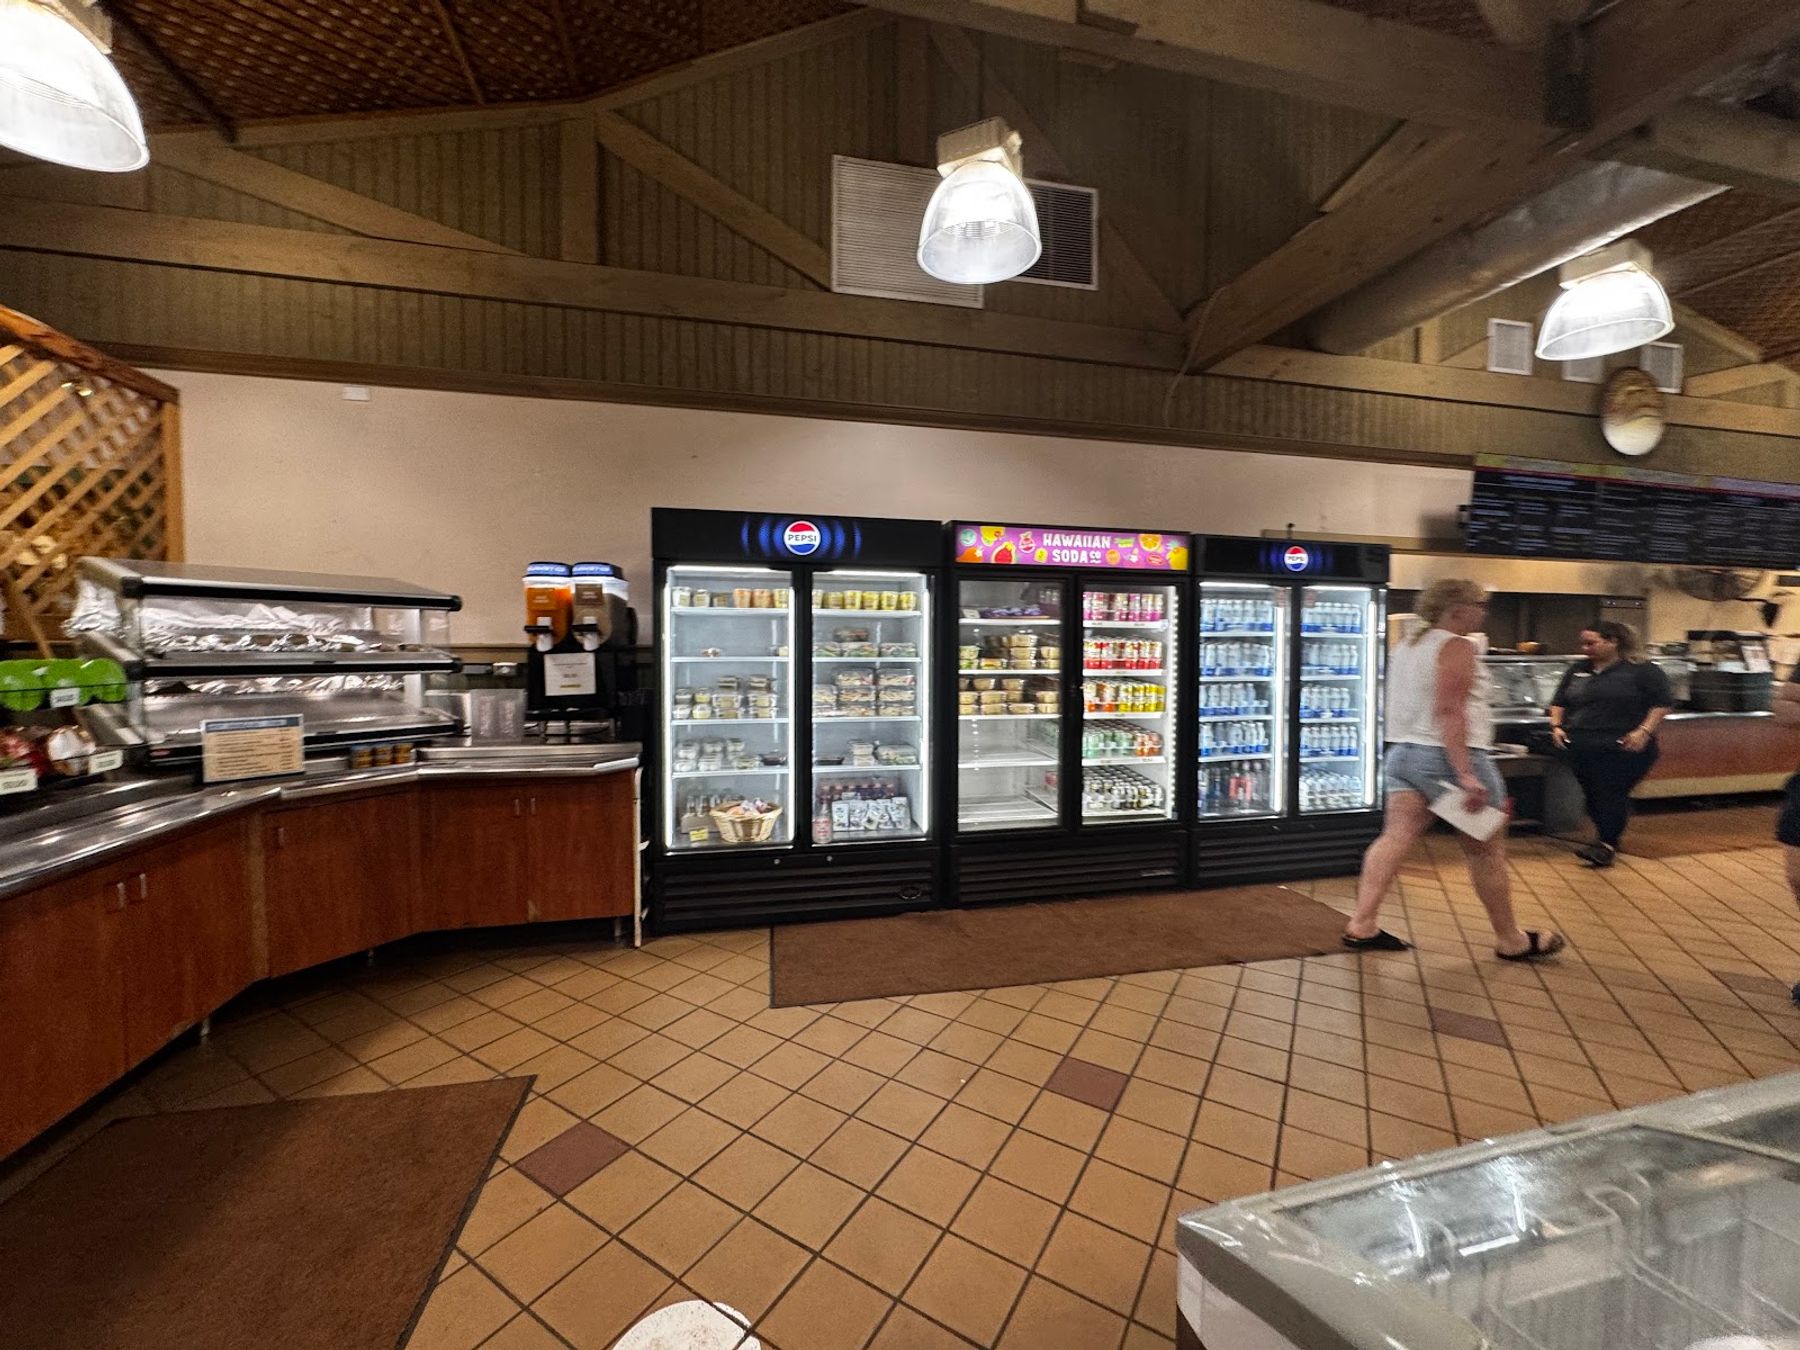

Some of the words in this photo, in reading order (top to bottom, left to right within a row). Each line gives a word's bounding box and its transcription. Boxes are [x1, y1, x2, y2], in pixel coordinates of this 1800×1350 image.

[788, 534, 817, 542] PEPSI
[1043, 533, 1112, 549] HAWAIIAN
[1052, 549, 1088, 563] SODA
